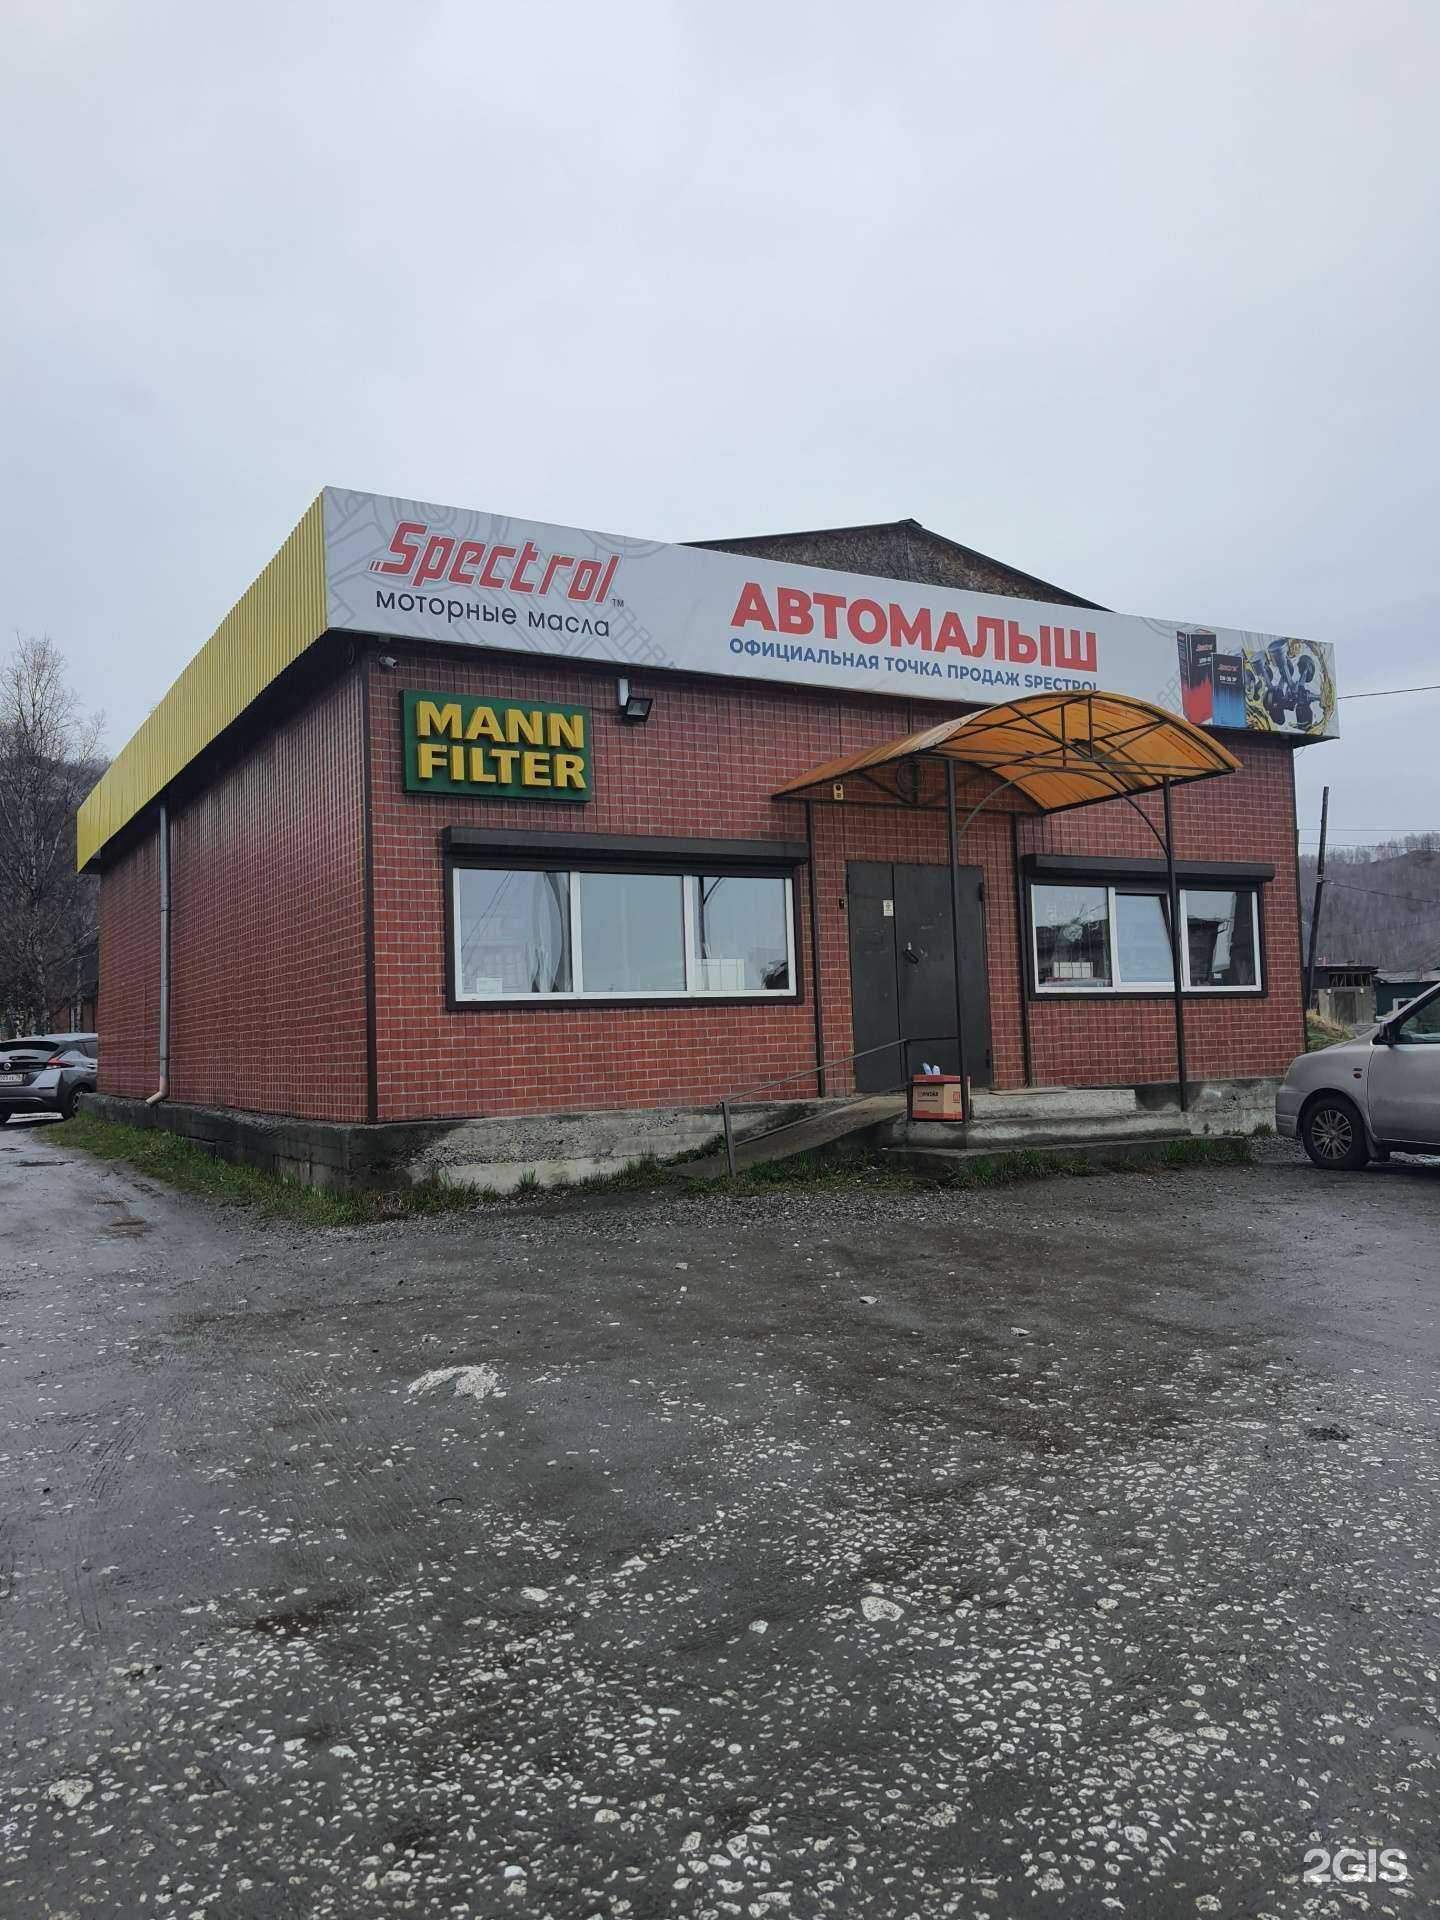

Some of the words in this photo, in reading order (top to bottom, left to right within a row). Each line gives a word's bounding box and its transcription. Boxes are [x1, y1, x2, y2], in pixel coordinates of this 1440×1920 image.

[369, 520, 623, 603] Spectrol
[376, 590, 517, 624] моторные
[528, 611, 610, 637] масла
[730, 582, 1098, 672] АВТОМАЛЫШ
[729, 638, 879, 670] ОФИЦИАЛЬНАЯ
[884, 656, 943, 677] ТОЧКА
[947, 664, 1020, 686] ПРОДАЖ
[416, 700, 585, 749] MANN
[417, 742, 587, 789] FILTER
